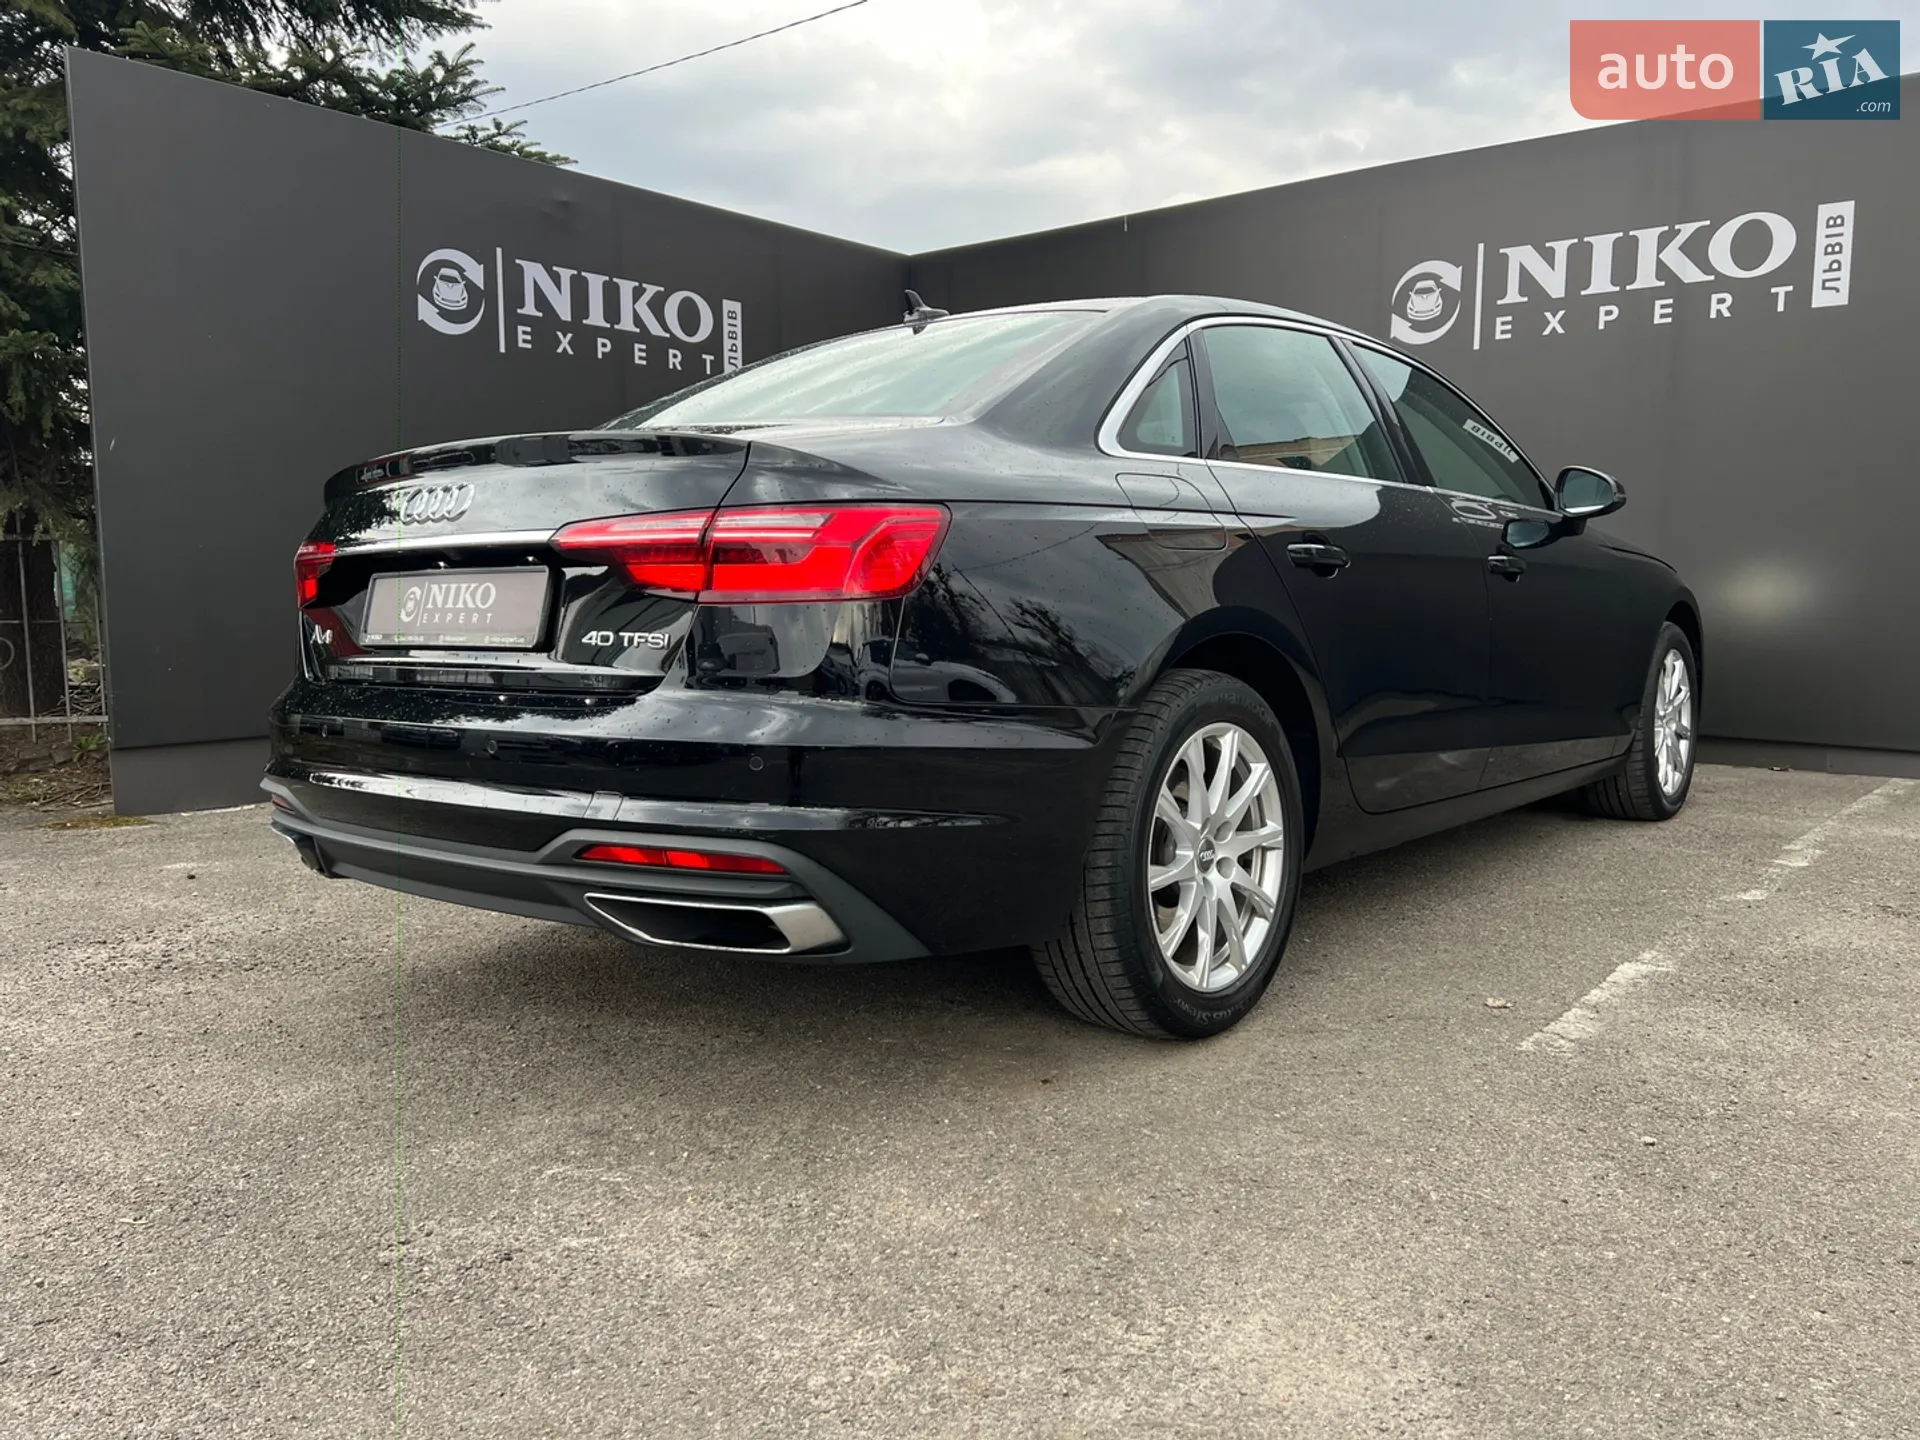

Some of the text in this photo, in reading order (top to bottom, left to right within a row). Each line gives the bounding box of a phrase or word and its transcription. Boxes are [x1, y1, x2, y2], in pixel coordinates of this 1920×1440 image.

[1497, 211, 1797, 305] NIKO
[1821, 213, 1845, 294] ЛЬВІВ
[515, 258, 714, 343] NIKO
[1495, 285, 1794, 340] EXPERT
[517, 325, 715, 375] EXPERT
[727, 309, 739, 369] ЛЬВІВ
[422, 612, 493, 624] EXPERT
[426, 582, 497, 609] NIKO
[581, 630, 672, 650] 40 TFSI
